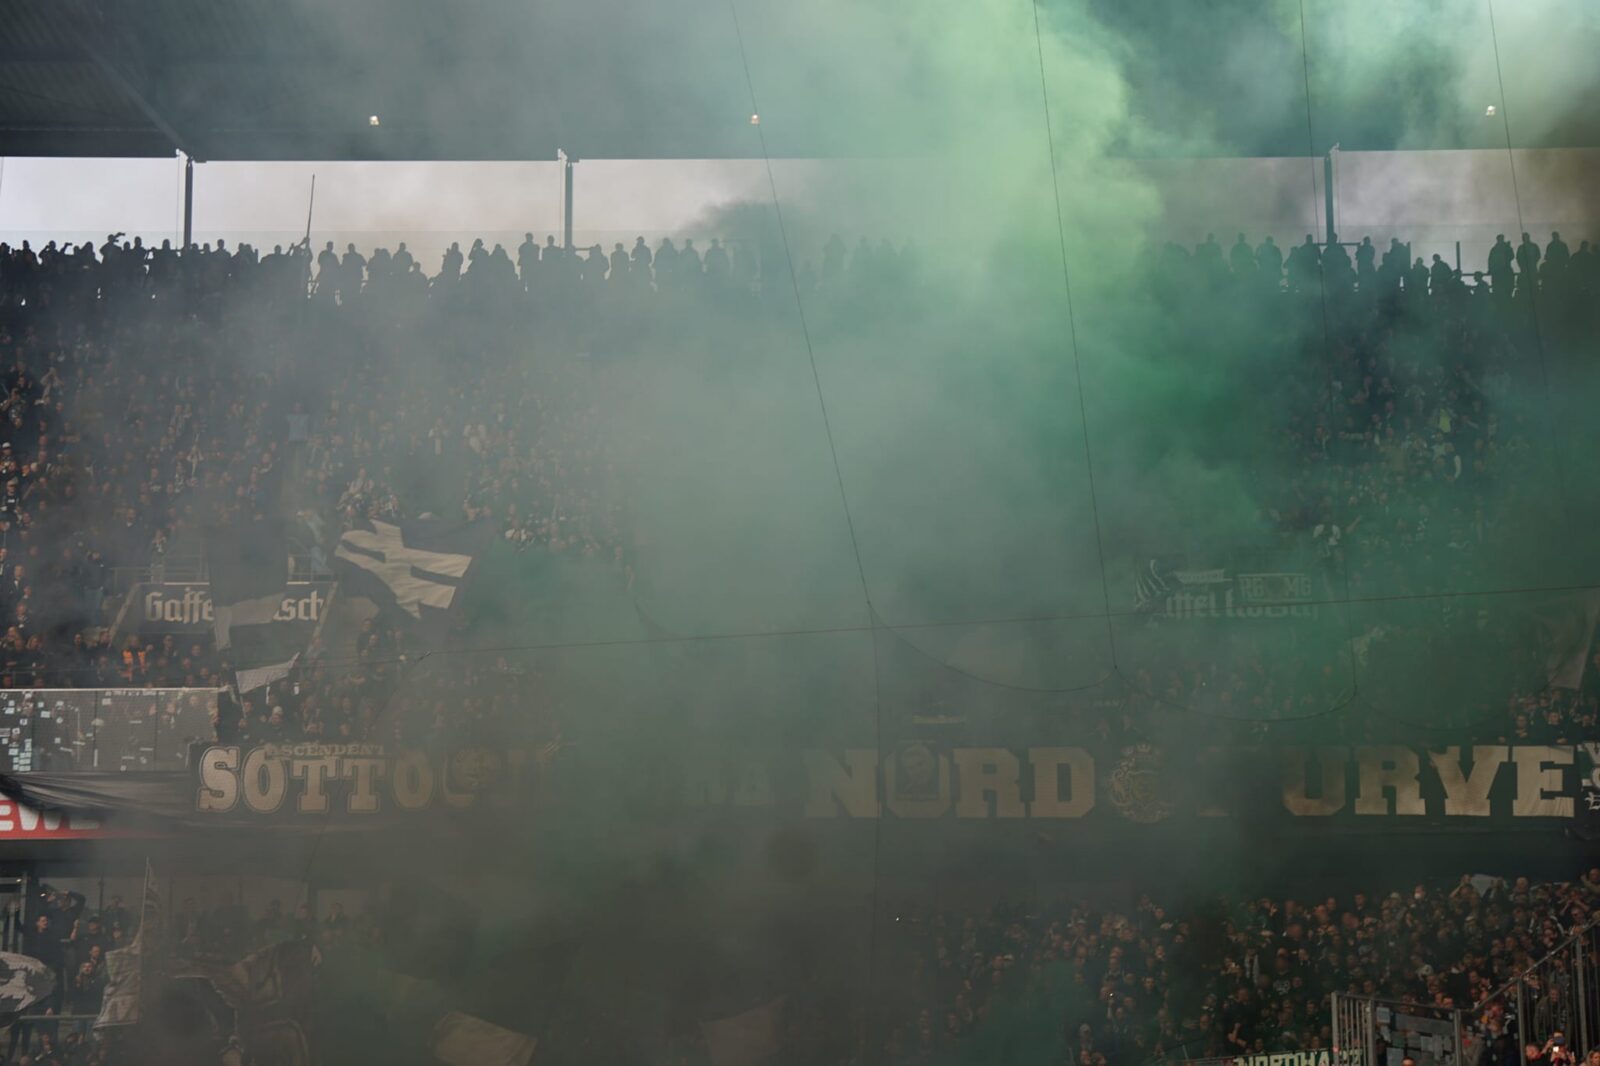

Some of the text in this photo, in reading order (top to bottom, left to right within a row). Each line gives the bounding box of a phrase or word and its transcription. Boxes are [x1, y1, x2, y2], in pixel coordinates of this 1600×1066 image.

[145, 586, 328, 625] Gaffe sch
[804, 747, 1096, 820] NORD
[1284, 747, 1575, 819] URVE
